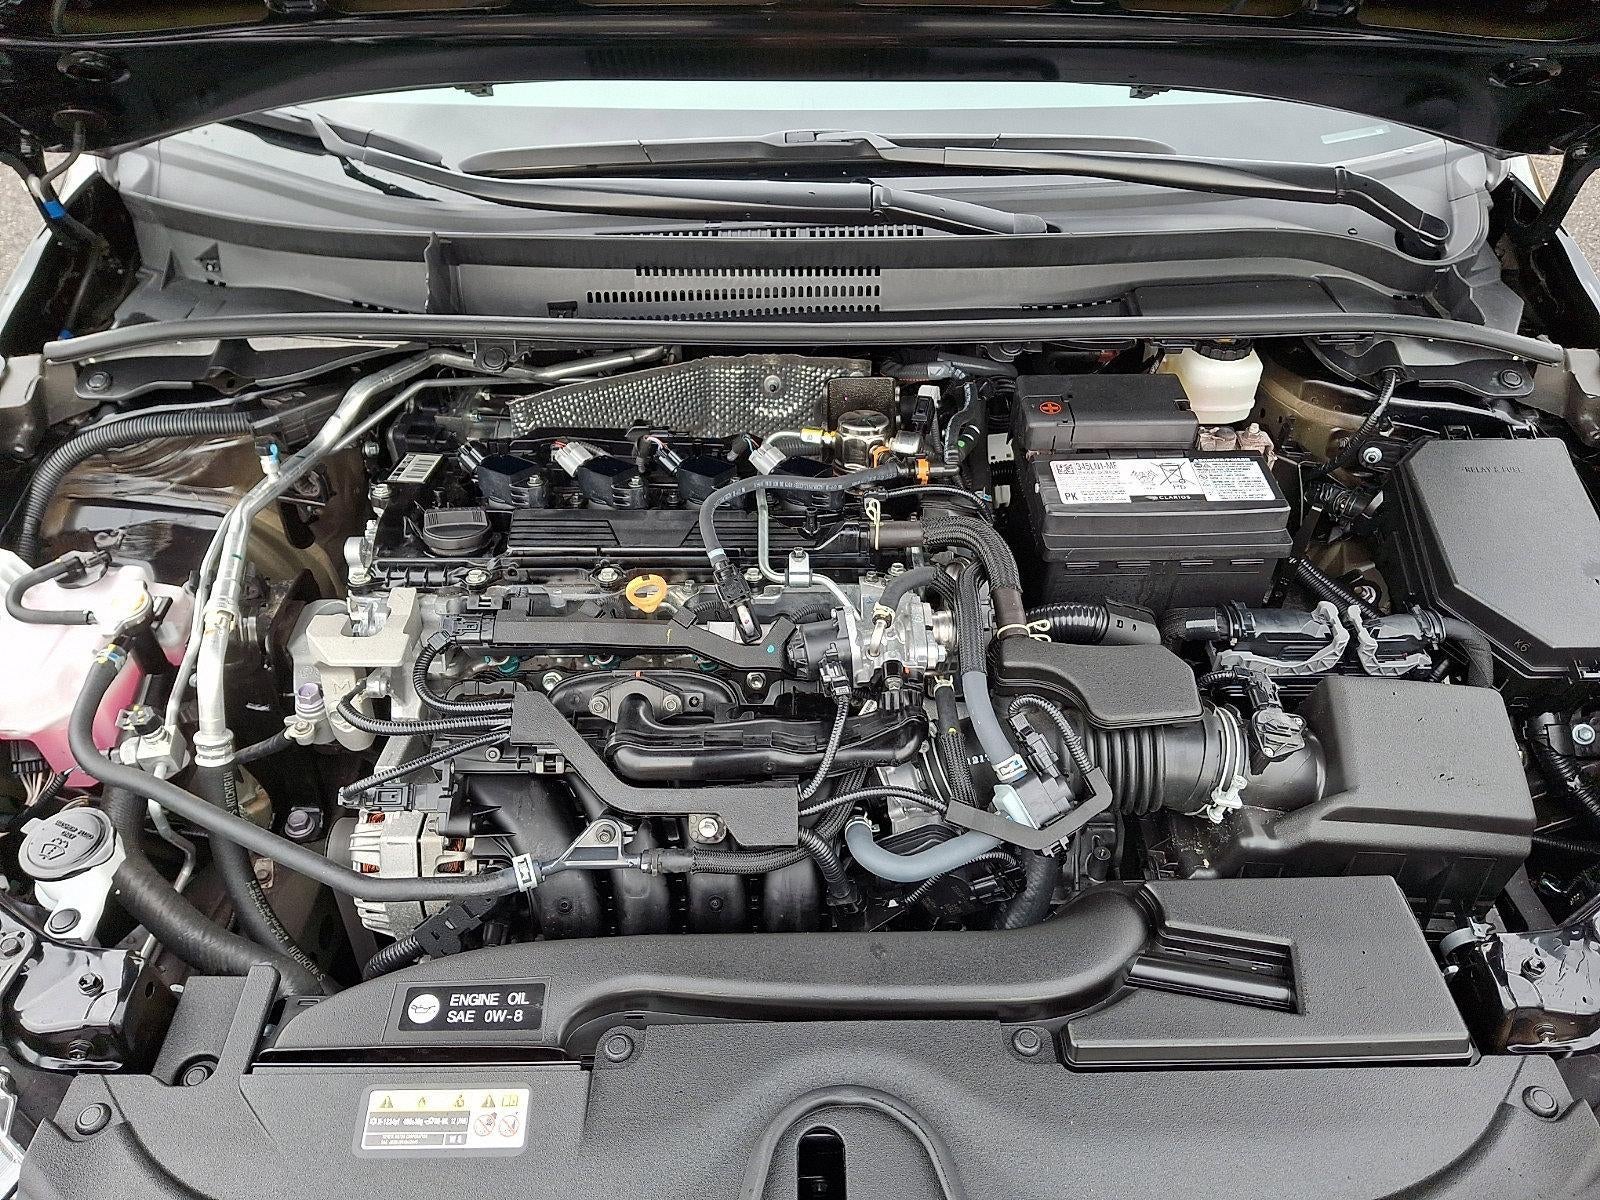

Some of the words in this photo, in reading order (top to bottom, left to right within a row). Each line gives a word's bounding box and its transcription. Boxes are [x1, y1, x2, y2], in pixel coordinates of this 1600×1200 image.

[1064, 492, 1078, 500] PK
[449, 993, 501, 1007] ENGINE
[507, 992, 530, 1006] OIL
[446, 1009, 476, 1024] SAE
[484, 1009, 524, 1023] 0W-8
